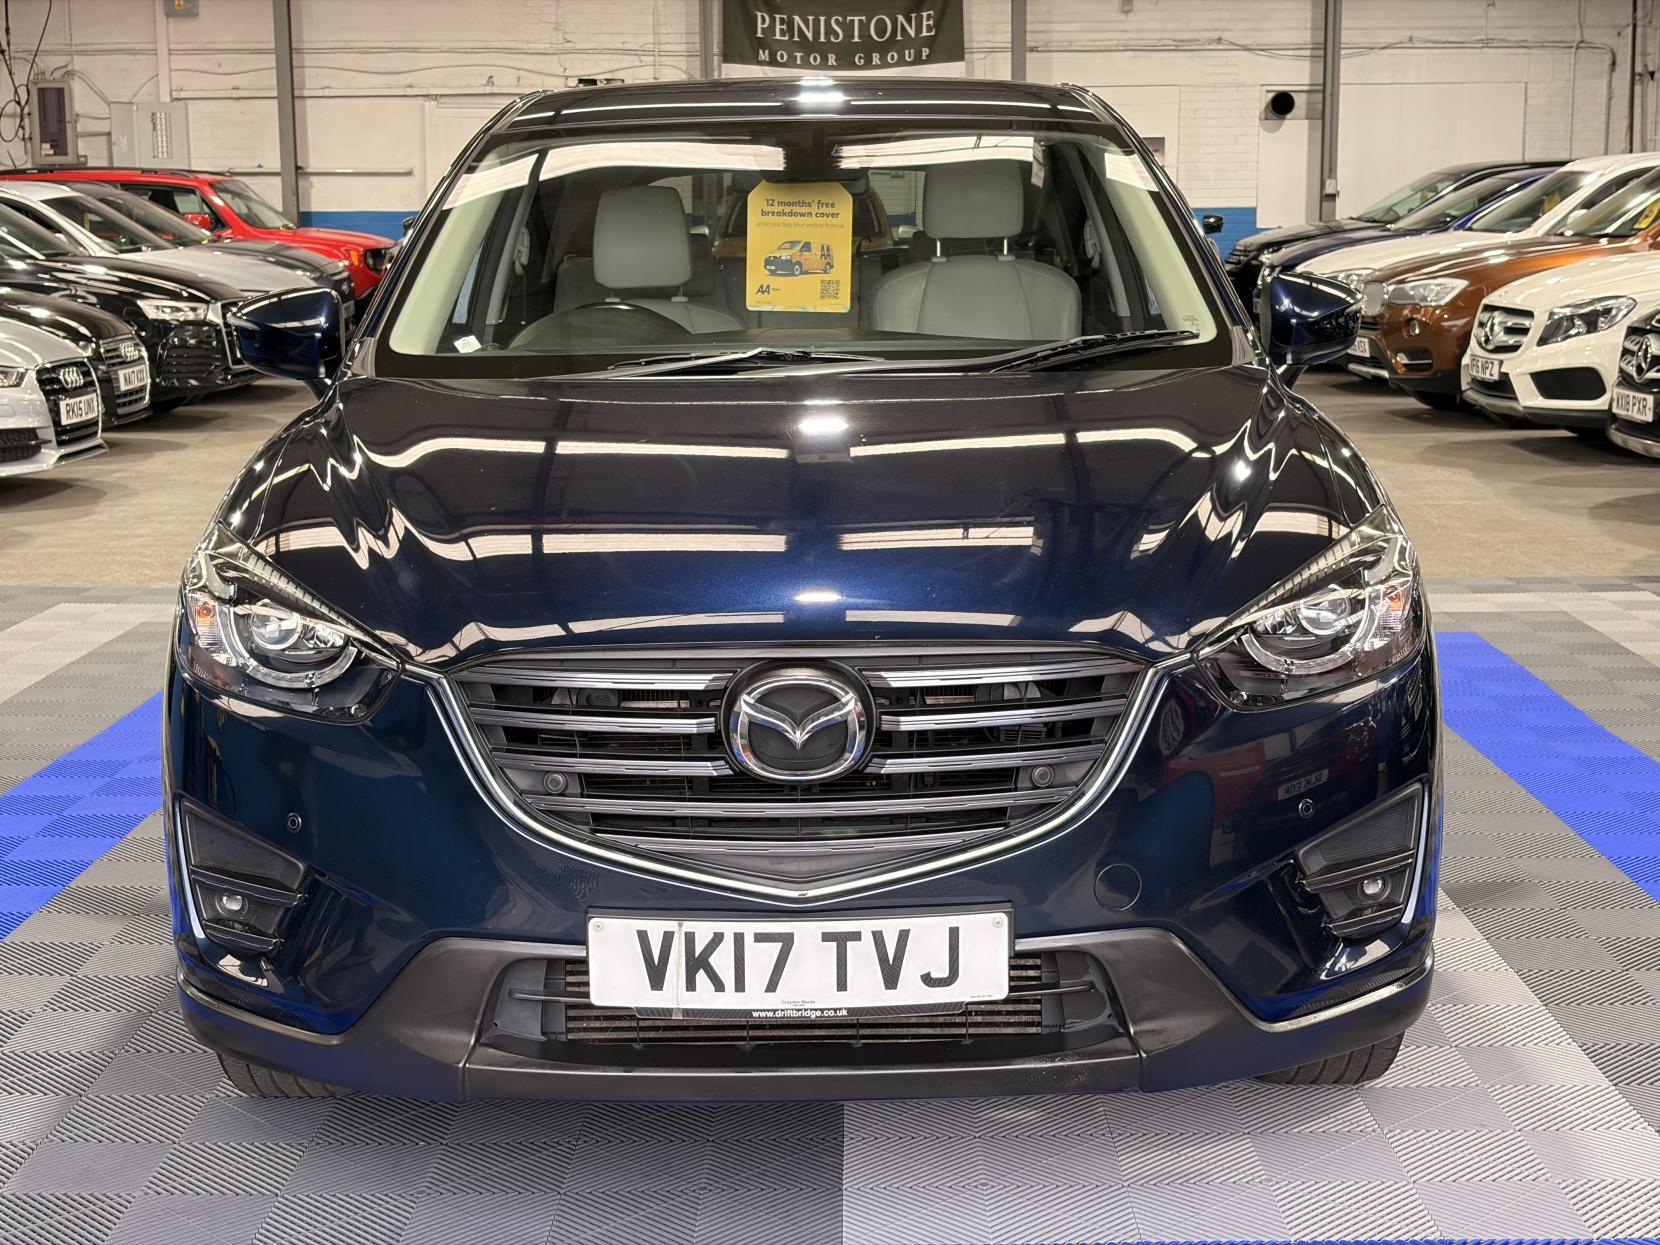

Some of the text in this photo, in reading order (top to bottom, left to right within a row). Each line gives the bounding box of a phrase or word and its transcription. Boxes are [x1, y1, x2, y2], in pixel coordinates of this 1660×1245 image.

[754, 10, 936, 43] PENISTONE
[758, 47, 930, 66] MOTOR GROUP
[765, 198, 775, 207] 12
[816, 199, 836, 210] free
[760, 208, 840, 219] breakdown cover
[820, 244, 831, 260] AA
[756, 284, 771, 295] AA
[1480, 359, 1495, 377] NPZ
[65, 400, 83, 421] RK15
[1631, 395, 1648, 417] PXR
[635, 926, 960, 994] VK17 TVJ
[752, 1008, 848, 1019] www.driftbridge.co.uk
